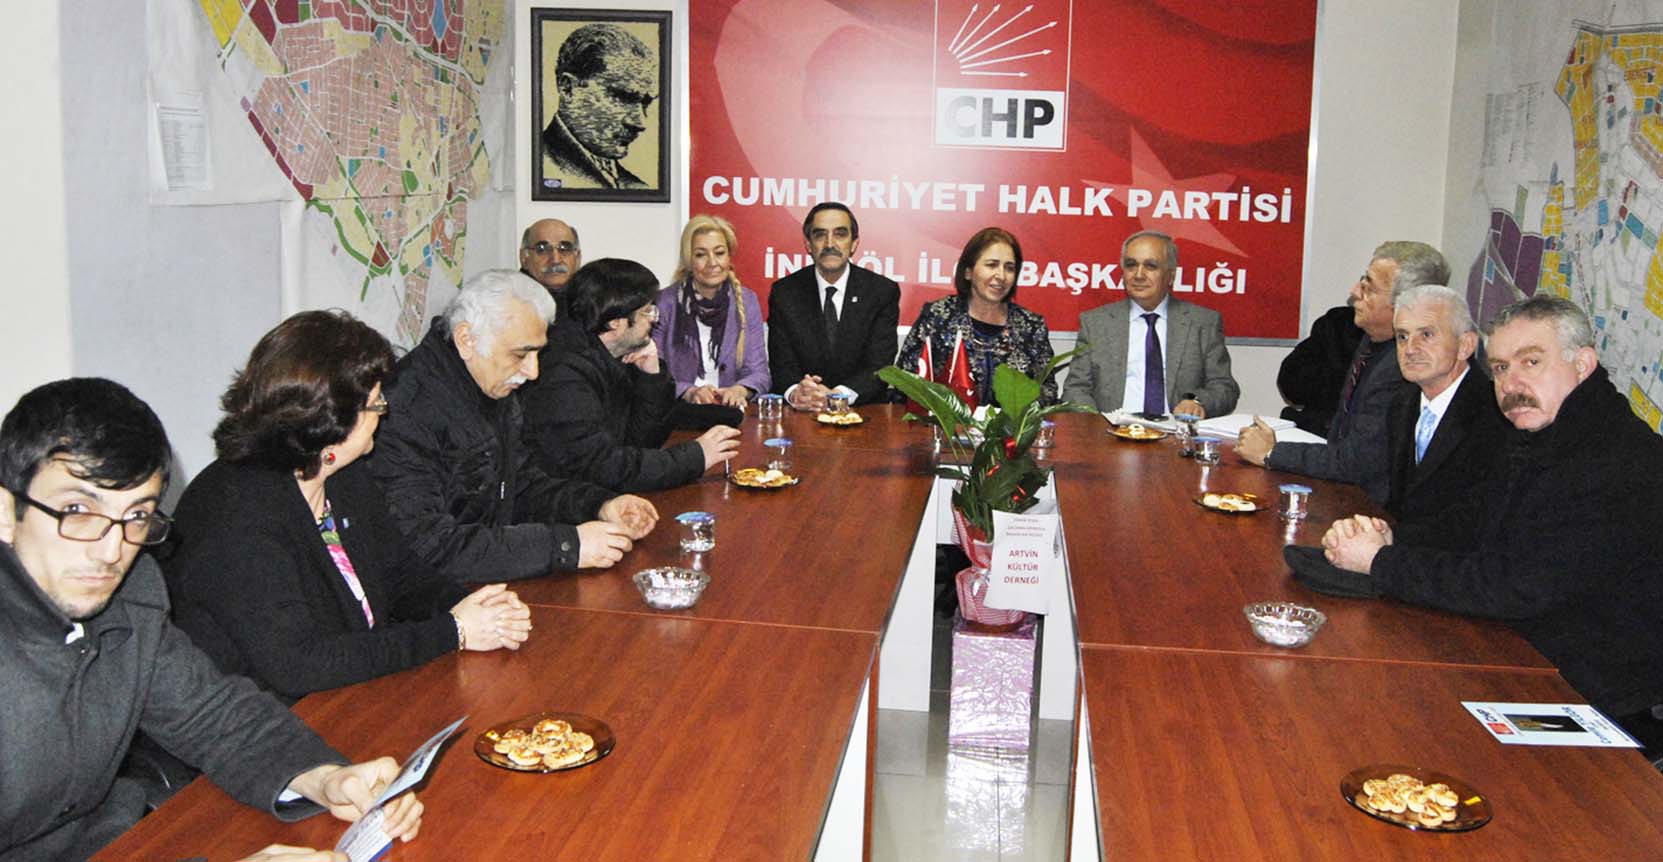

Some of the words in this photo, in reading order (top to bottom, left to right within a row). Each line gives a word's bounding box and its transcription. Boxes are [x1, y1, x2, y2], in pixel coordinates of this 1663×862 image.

[943, 95, 1056, 139] CHP
[702, 175, 985, 211] CUMHURİYET
[998, 184, 1114, 217] HALK
[1128, 186, 1293, 223] PARTİSİ
[764, 247, 905, 282] İNÖL
[1017, 260, 1247, 296] BAŞKLIĞI
